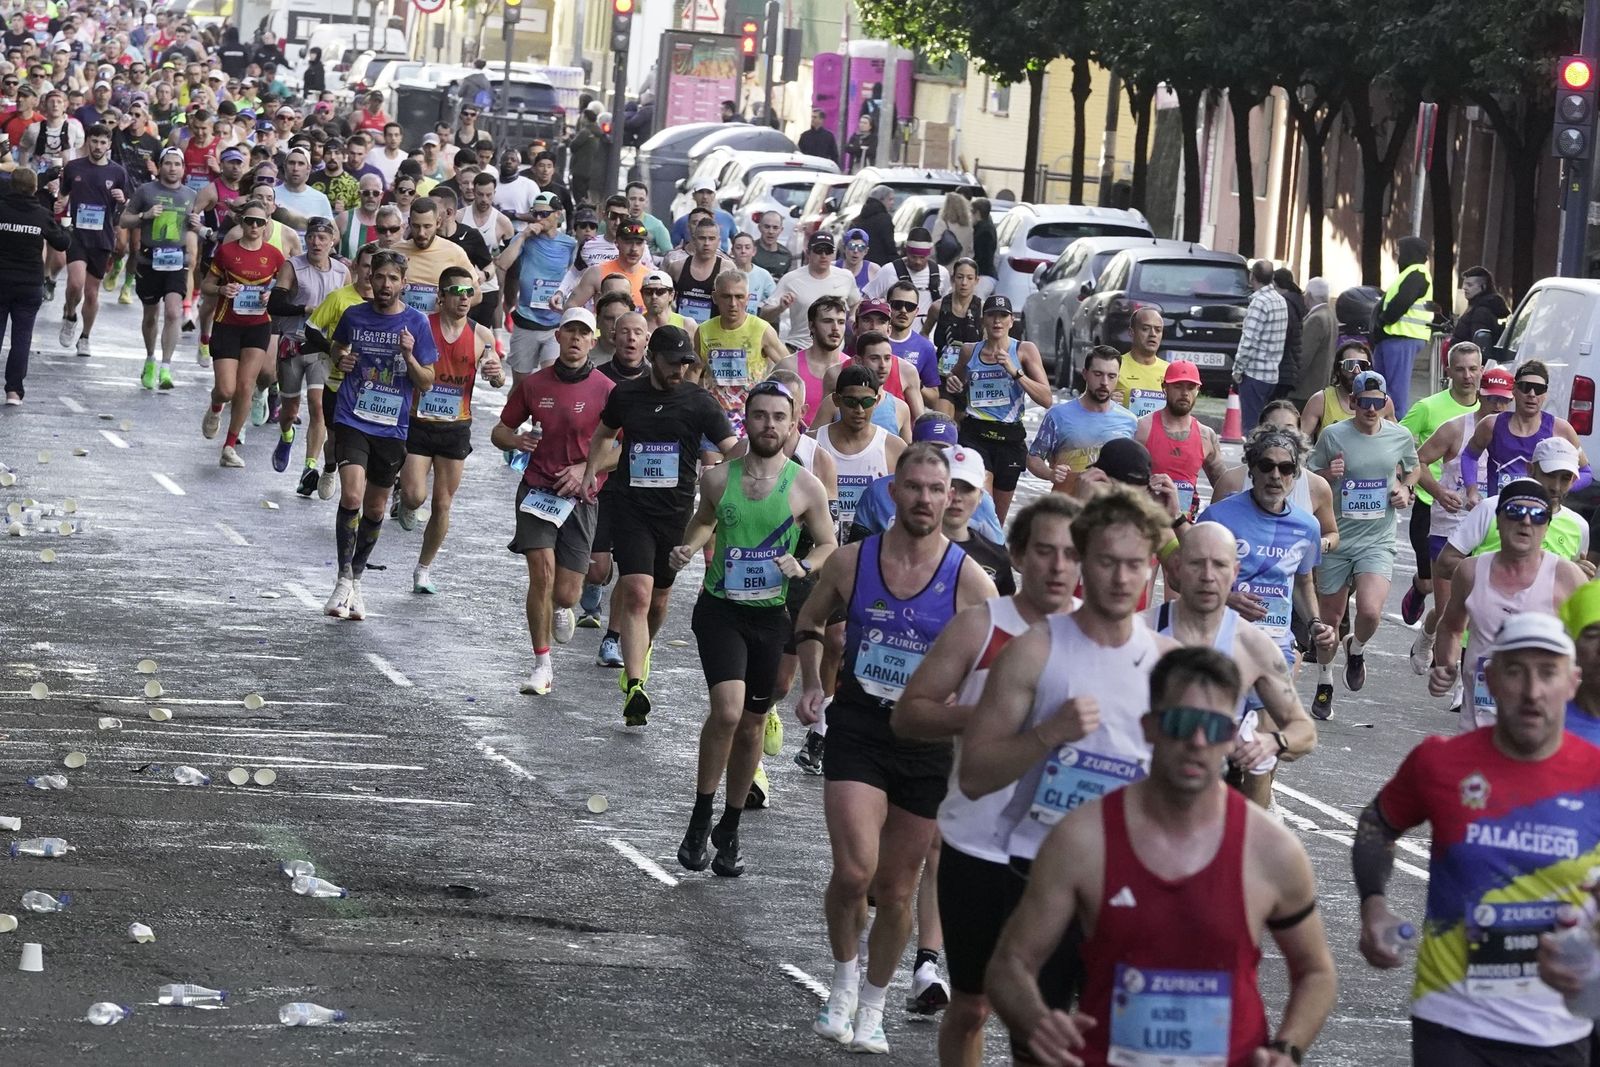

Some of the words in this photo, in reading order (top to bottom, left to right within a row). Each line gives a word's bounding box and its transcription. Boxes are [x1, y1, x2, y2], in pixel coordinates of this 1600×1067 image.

[0, 223, 42, 235] VOLUNTEER
[412, 285, 435, 293] ZURICH
[363, 330, 401, 340] CARRER
[712, 368, 743, 377] PATRICK
[1488, 377, 1508, 386] MAGA
[374, 384, 400, 395] ZURICH
[986, 389, 1005, 398] PEPA
[1143, 391, 1165, 399] ZURICH
[358, 400, 367, 410] EL
[370, 402, 398, 416] GUAPO
[425, 402, 454, 415] TULKAS
[646, 444, 674, 452] ZURICH
[643, 467, 664, 477] NEIL
[531, 502, 561, 516] JULIEN
[1348, 500, 1381, 510] CARLOS
[745, 549, 777, 559] ZURICH
[746, 566, 764, 574] 9628
[743, 576, 766, 589] BEN
[1253, 585, 1284, 594] ZURICH
[886, 635, 928, 652] ZURICH
[883, 654, 905, 667] 6729
[1082, 756, 1136, 778] ZURICH
[1044, 786, 1085, 810] CLÉ
[1465, 822, 1579, 859] PALACIEGO
[1151, 975, 1218, 992] ZURICH
[1143, 1027, 1193, 1050] LUIS
